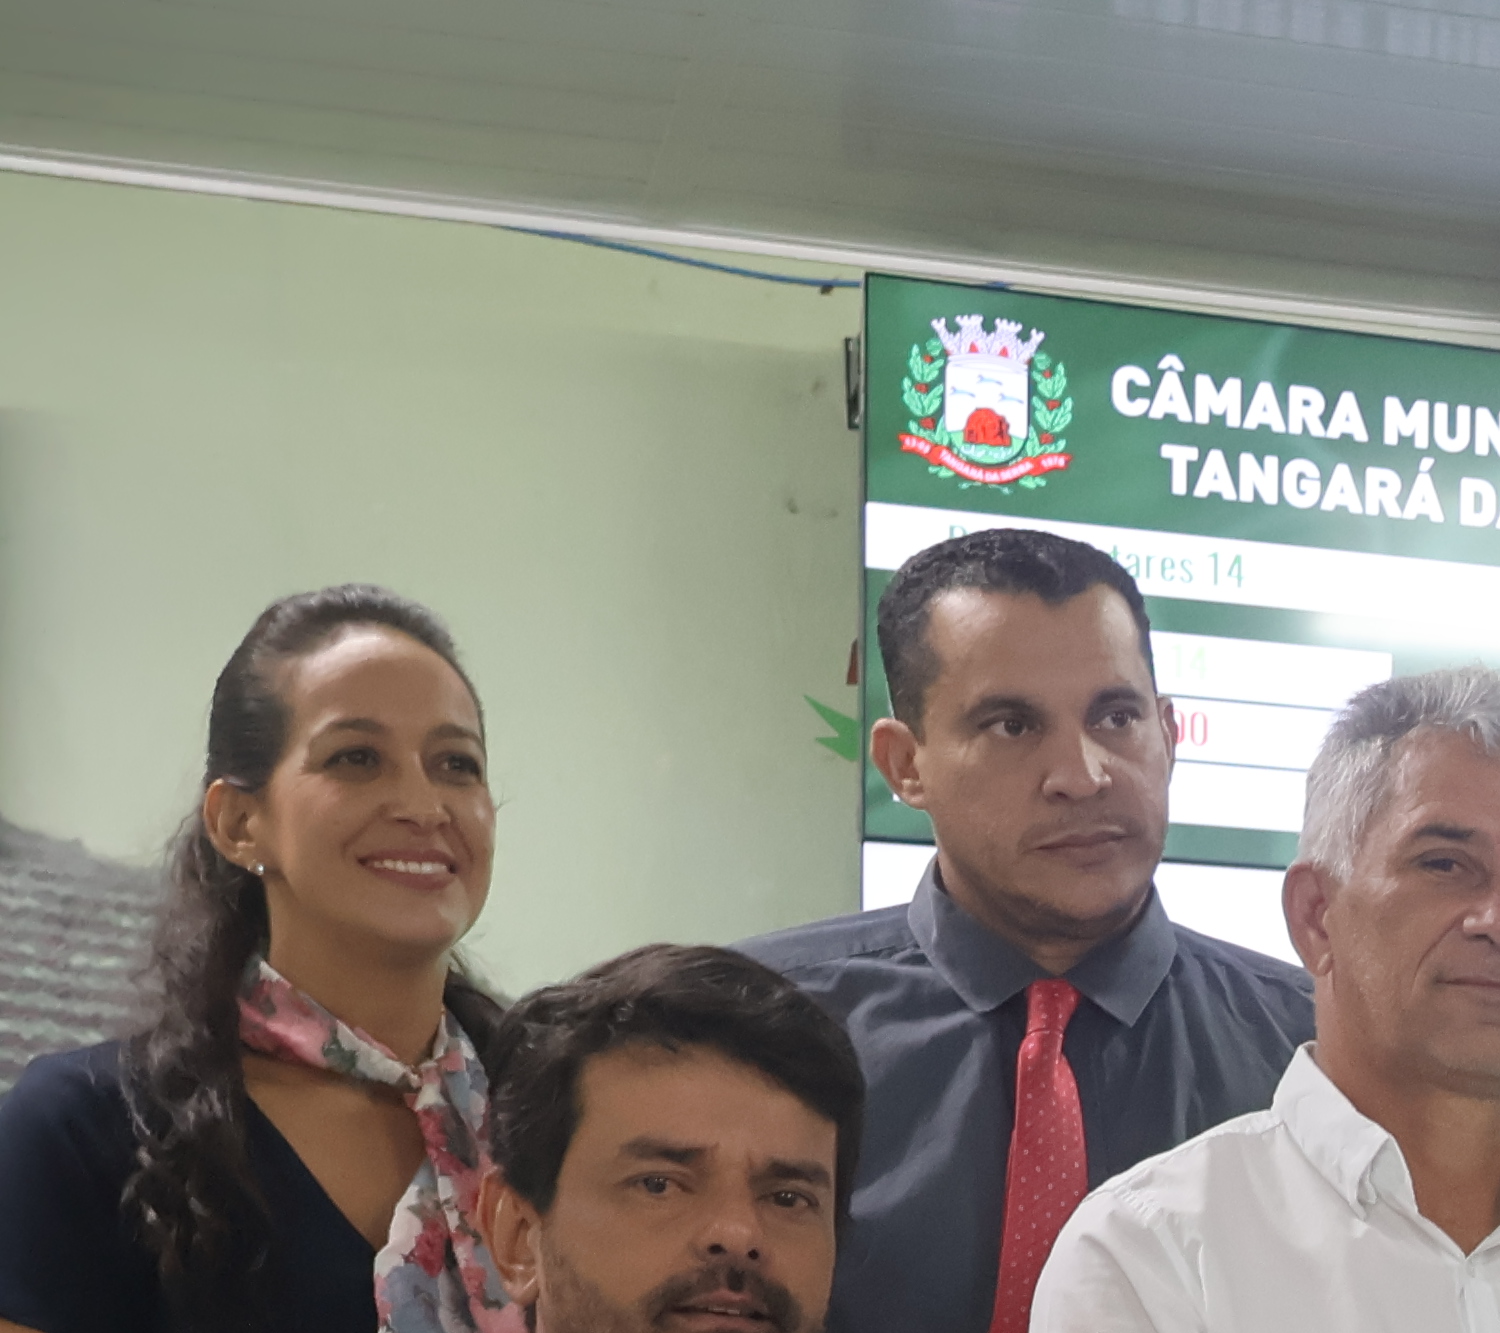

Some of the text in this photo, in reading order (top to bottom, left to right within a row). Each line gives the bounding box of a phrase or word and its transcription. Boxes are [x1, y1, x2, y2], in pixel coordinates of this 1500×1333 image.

[1111, 354, 1369, 443] CÂMARA
[1160, 443, 1445, 523] TANGARÁ
[1207, 552, 1244, 588] 14
